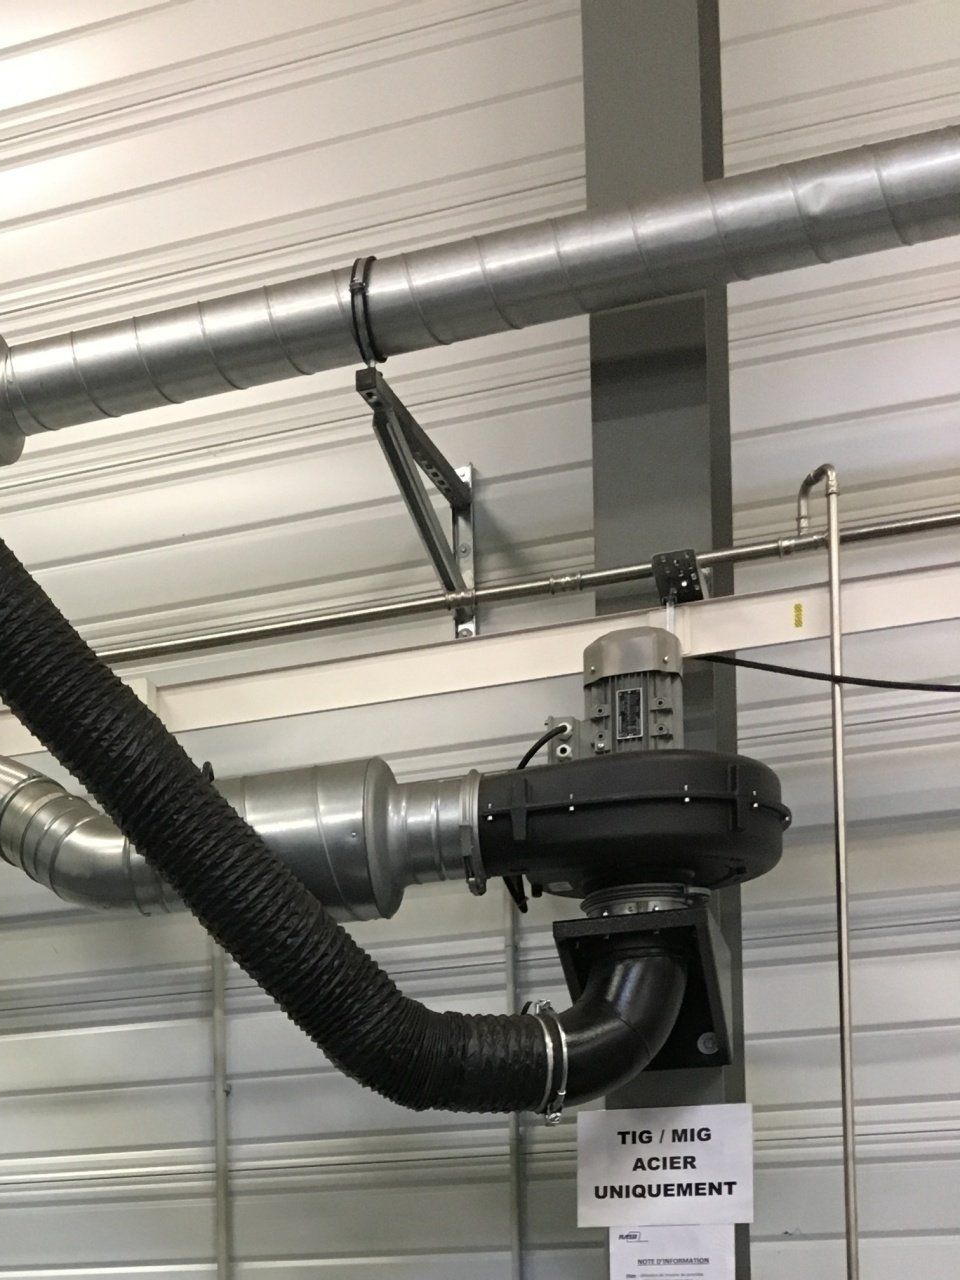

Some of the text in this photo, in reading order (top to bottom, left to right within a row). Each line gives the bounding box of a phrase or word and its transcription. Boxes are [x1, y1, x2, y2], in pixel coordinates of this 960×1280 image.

[617, 1127, 712, 1145] TIG / MIG
[632, 1155, 697, 1171] ACIER
[594, 1181, 737, 1199] UNIQUEMENT
[637, 1257, 710, 1266] NOTE D'INFORMATION
